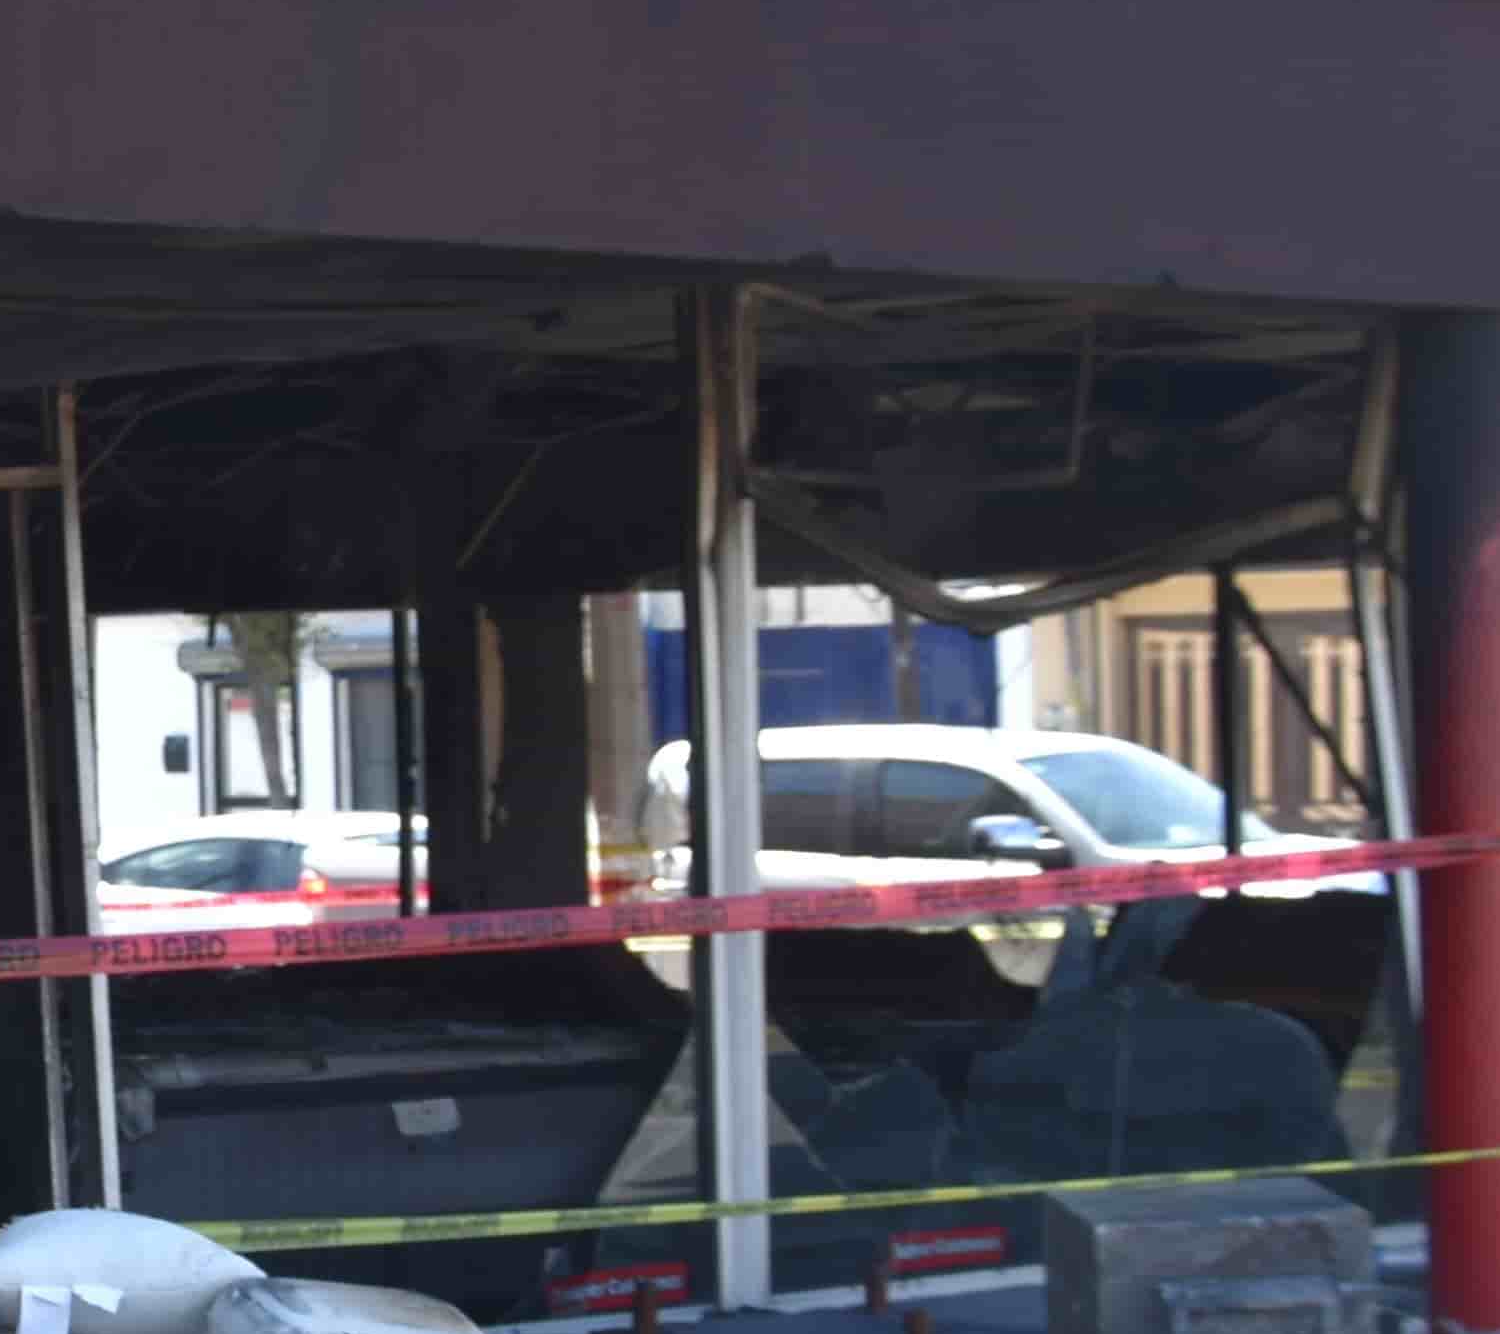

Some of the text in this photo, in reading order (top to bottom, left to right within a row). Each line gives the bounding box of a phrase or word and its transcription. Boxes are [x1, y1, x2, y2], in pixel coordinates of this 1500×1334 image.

[92, 934, 227, 966] PELIGRO
[273, 925, 404, 957] PELIGRO
[446, 912, 570, 945] PELIGRO
